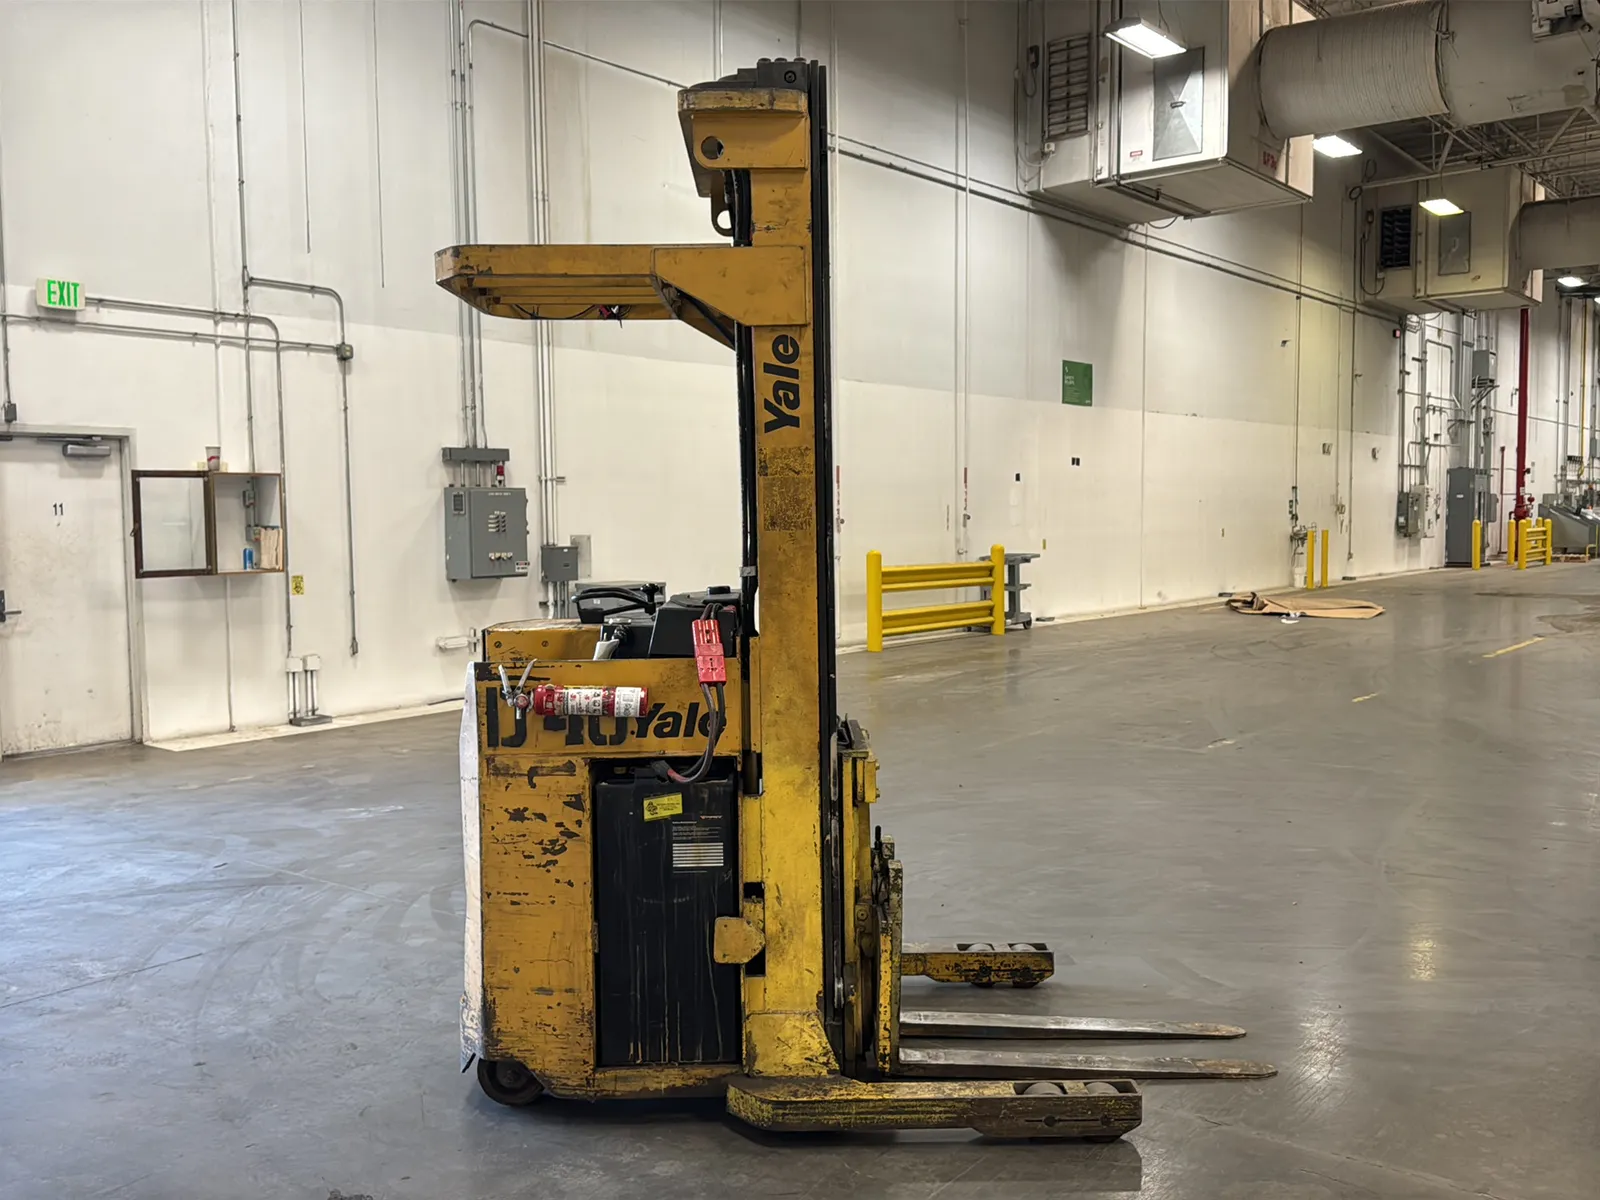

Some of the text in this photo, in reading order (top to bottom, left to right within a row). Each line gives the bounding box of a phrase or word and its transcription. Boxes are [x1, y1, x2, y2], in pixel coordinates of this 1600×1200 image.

[47, 279, 80, 308] EXIT
[763, 334, 800, 434] Yale
[52, 502, 64, 516] 11
[634, 702, 727, 739] Yale
